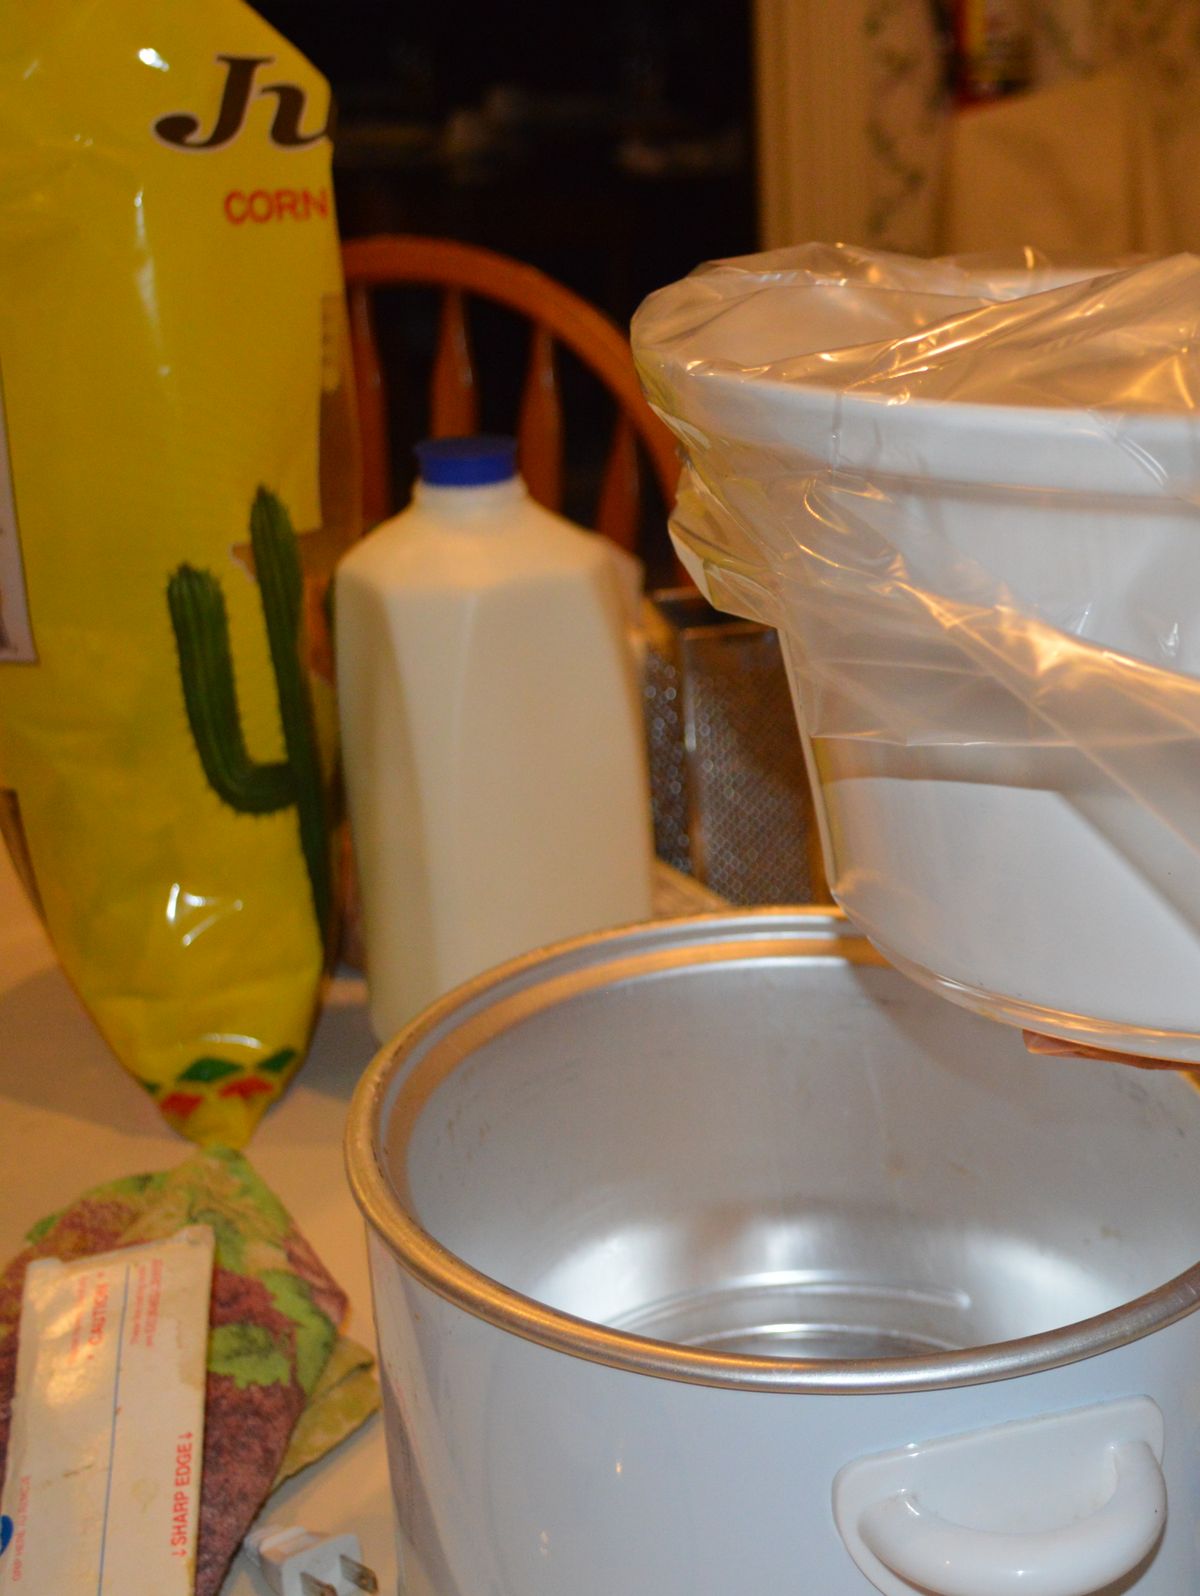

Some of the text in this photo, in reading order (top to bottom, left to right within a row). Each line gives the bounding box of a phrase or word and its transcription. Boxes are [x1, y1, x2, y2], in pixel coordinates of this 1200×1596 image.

[224, 186, 329, 226] CORN
[88, 1282, 109, 1346] CAUTION
[171, 1443, 193, 1546] SHARP EDGE
